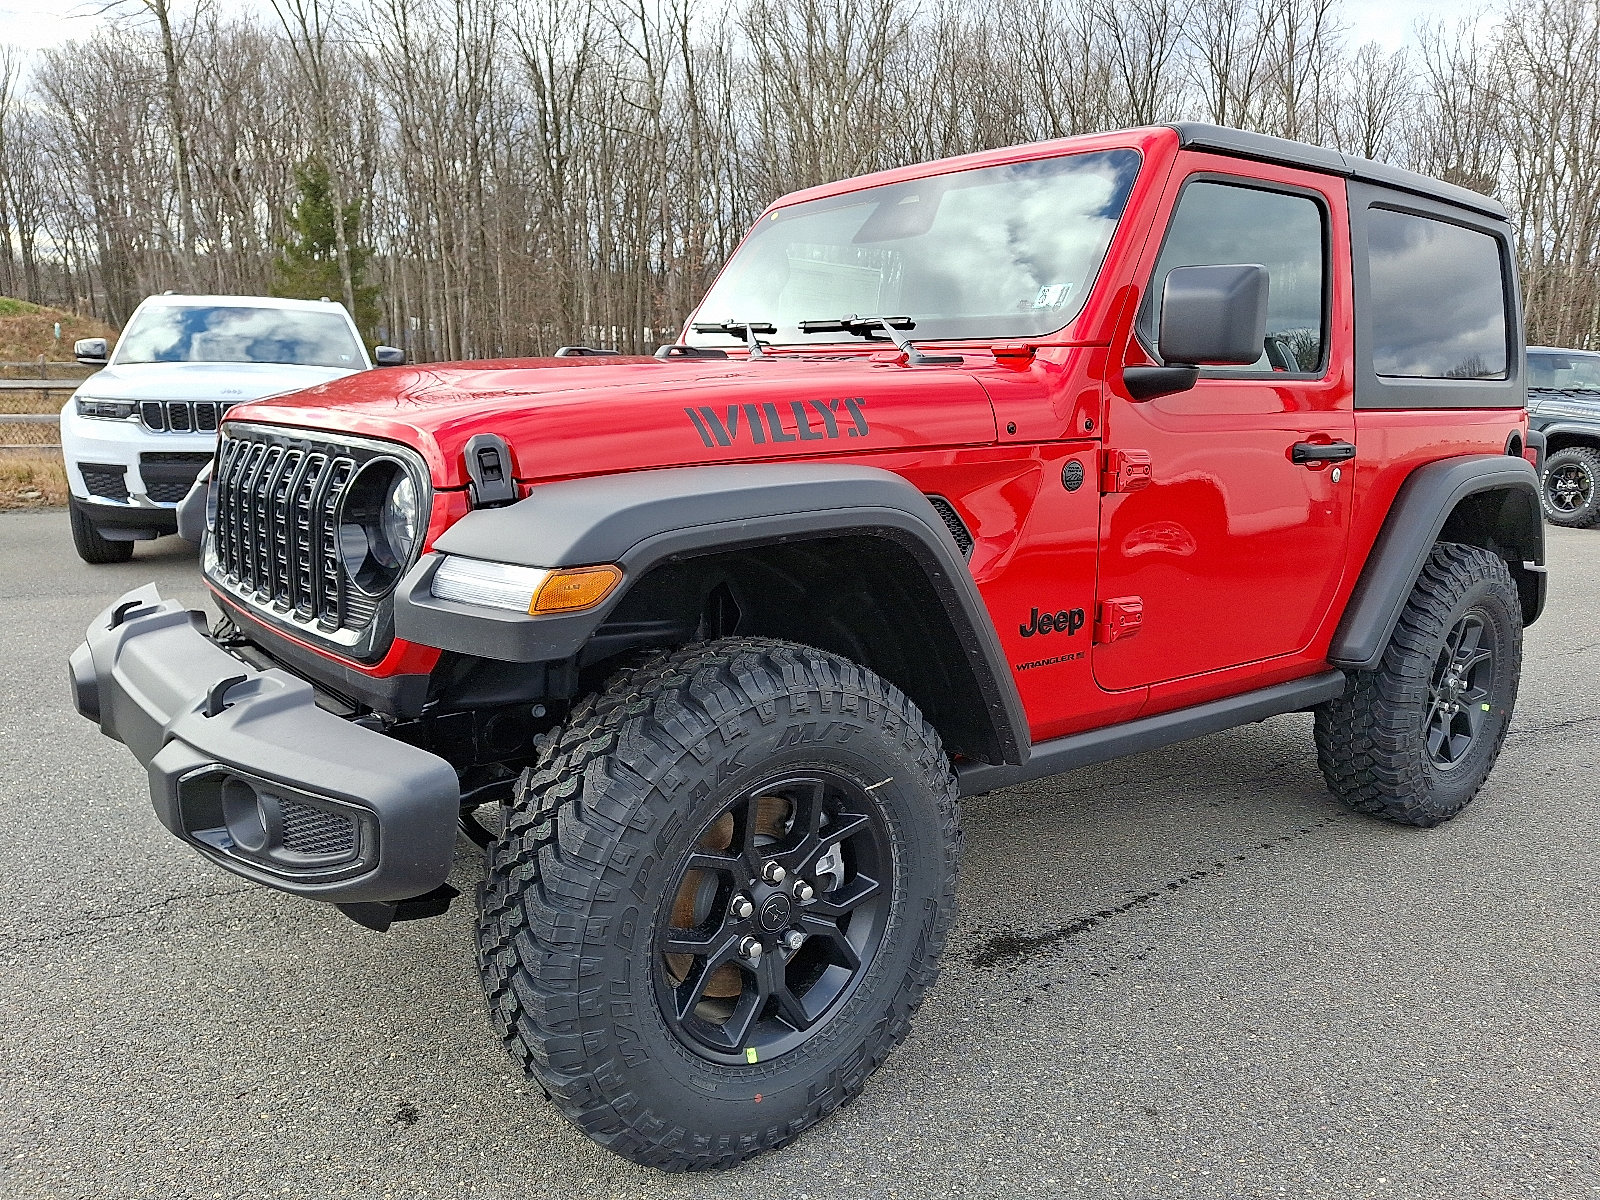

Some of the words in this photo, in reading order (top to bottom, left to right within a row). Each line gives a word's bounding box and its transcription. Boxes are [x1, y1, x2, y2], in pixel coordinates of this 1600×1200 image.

[684, 397, 870, 448] WILLYS
[1019, 607, 1085, 637] Jeep
[1016, 653, 1075, 671] WRANGLER
[610, 745, 748, 1069] WILDPEAK
[771, 721, 864, 751] M/T
[806, 896, 939, 1108] FALKEN
